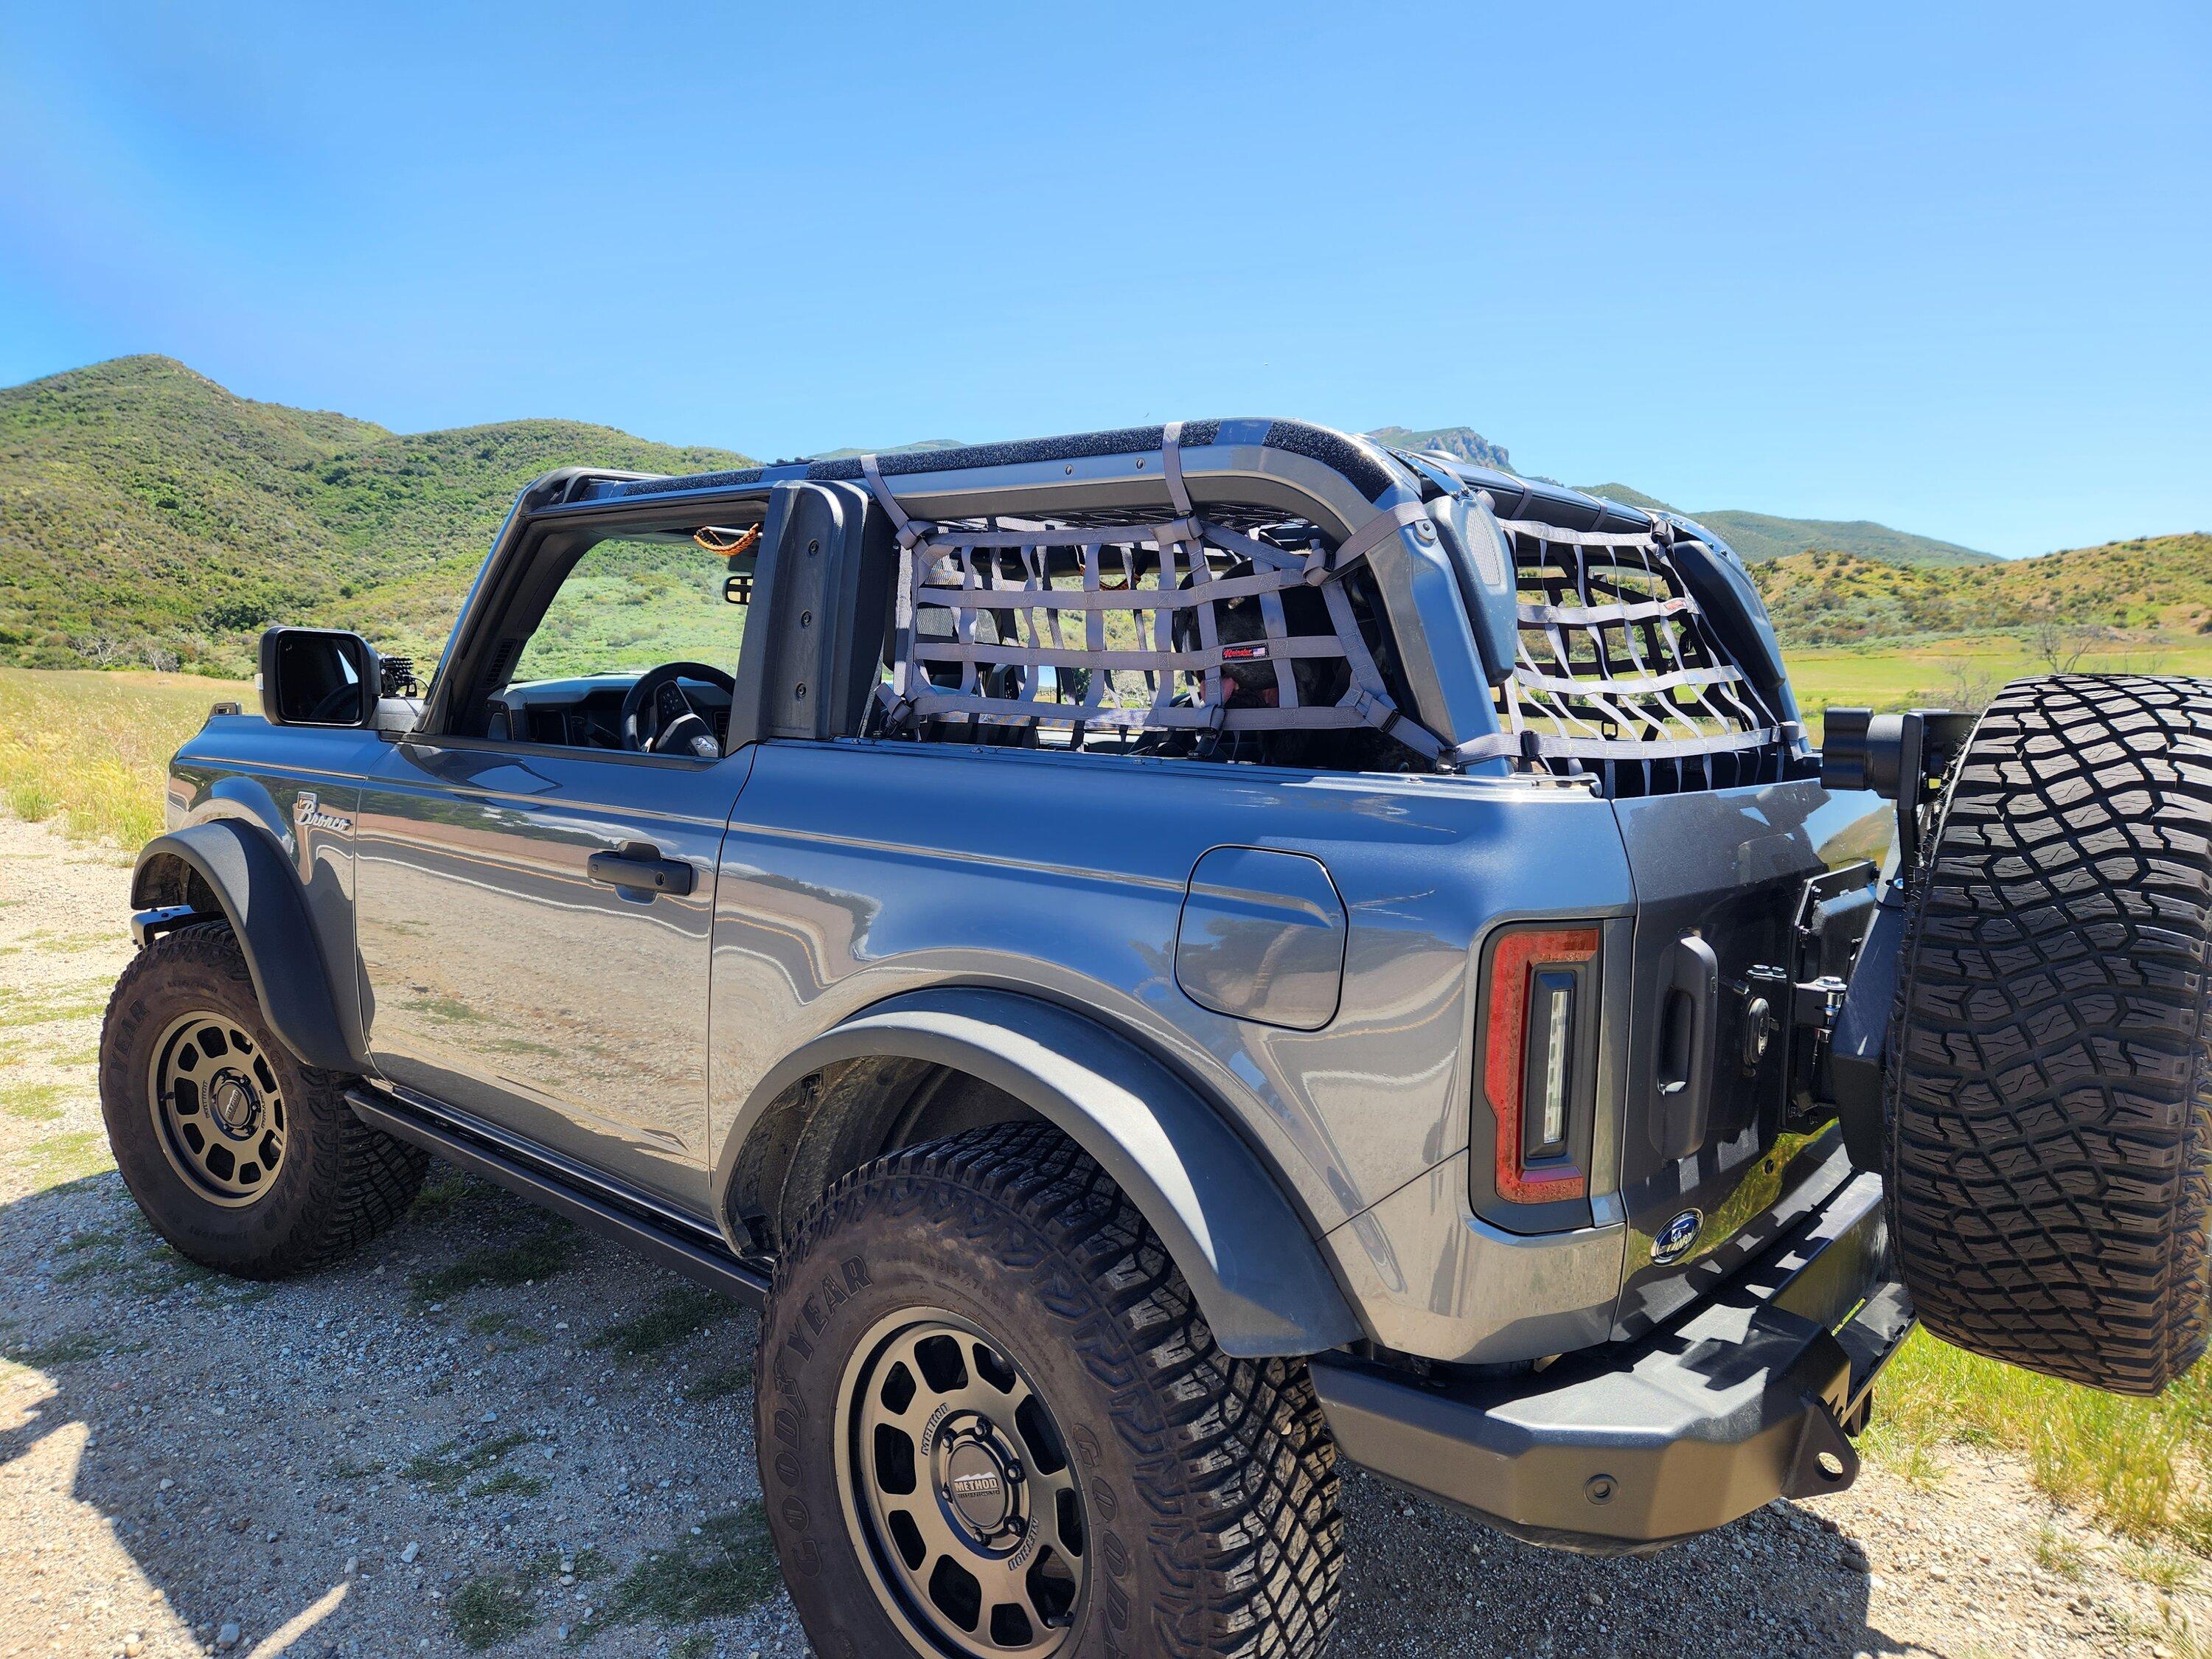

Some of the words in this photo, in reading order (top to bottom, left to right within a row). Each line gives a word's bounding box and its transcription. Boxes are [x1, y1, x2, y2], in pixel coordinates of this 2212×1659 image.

[295, 800, 353, 832] Bronco
[920, 1402, 950, 1456] METHOD
[953, 1477, 999, 1492] METHOD
[1007, 1516, 1039, 1571] METHOD
